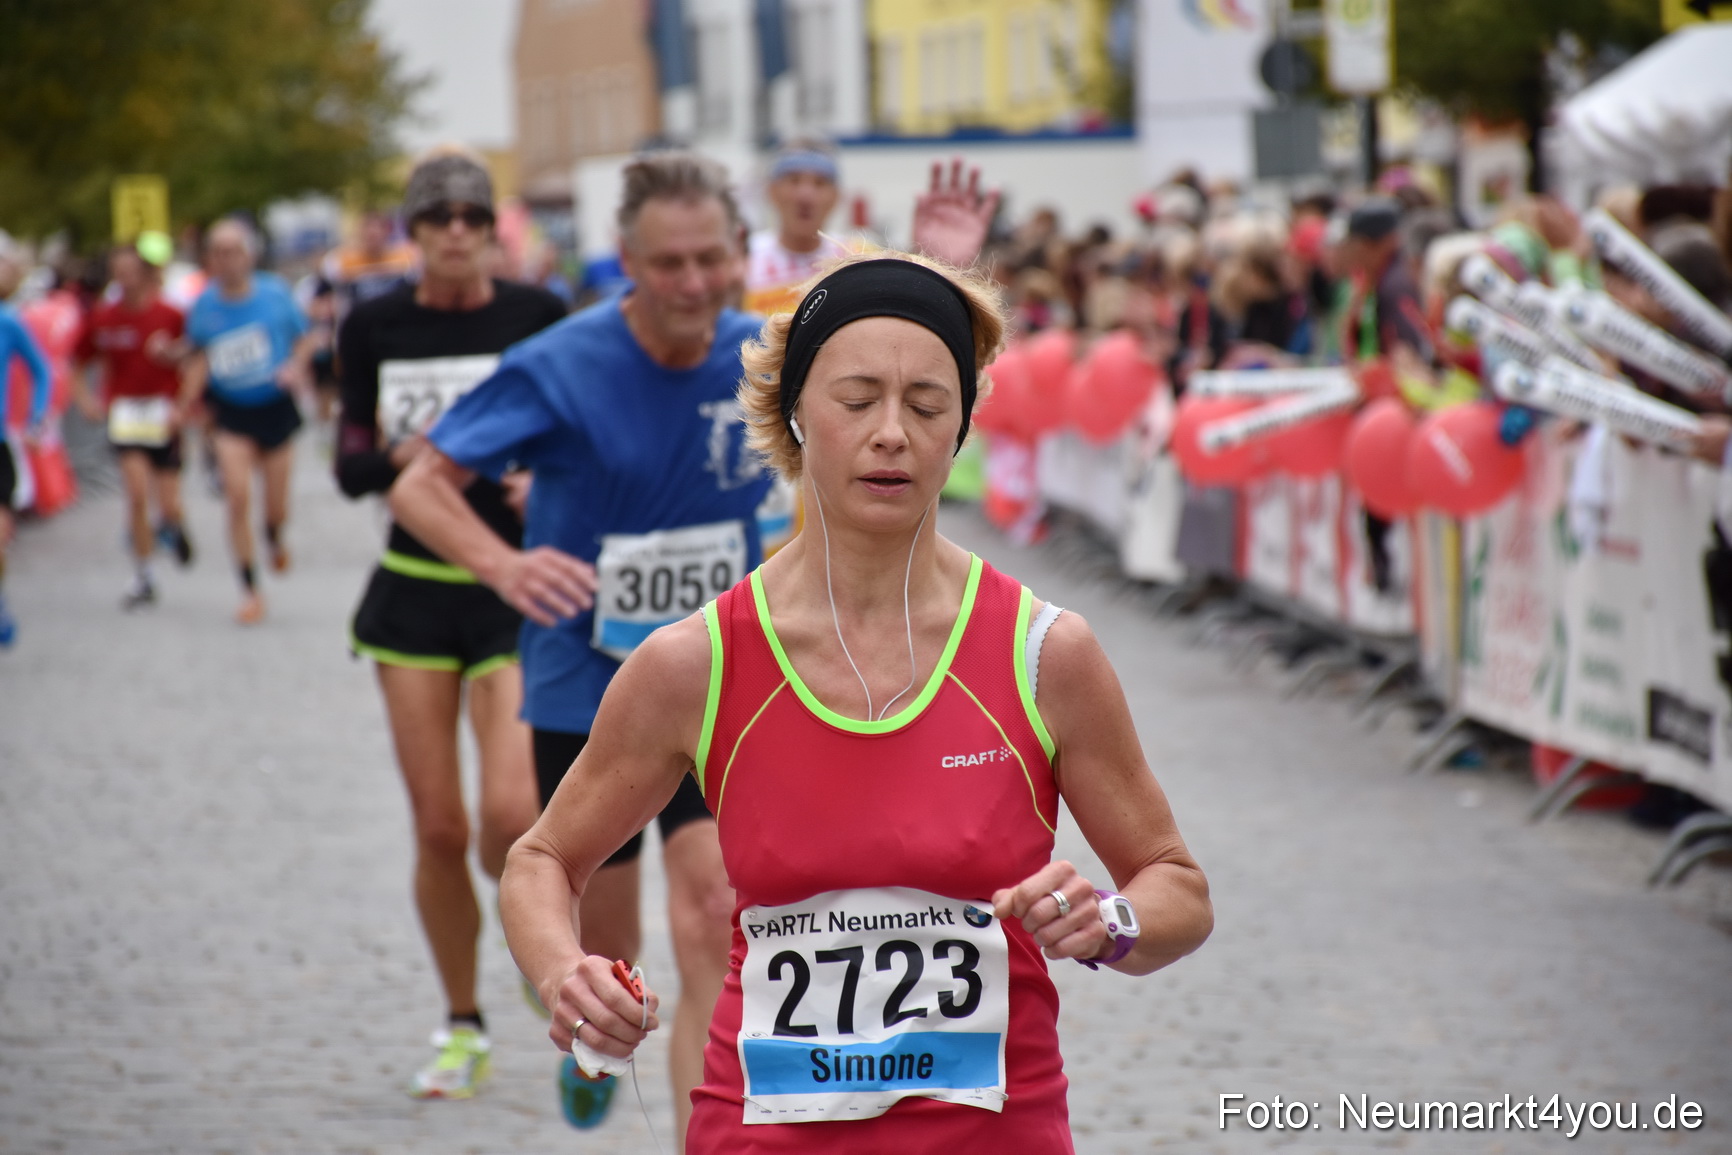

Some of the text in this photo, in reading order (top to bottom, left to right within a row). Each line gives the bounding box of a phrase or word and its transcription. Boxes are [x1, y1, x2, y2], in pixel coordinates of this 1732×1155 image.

[616, 559, 732, 613] 3059
[941, 749, 997, 768] CRAFT
[748, 906, 955, 938] PARTL Neumarkt
[767, 939, 983, 1037] 2723
[810, 1048, 934, 1083] Simone
